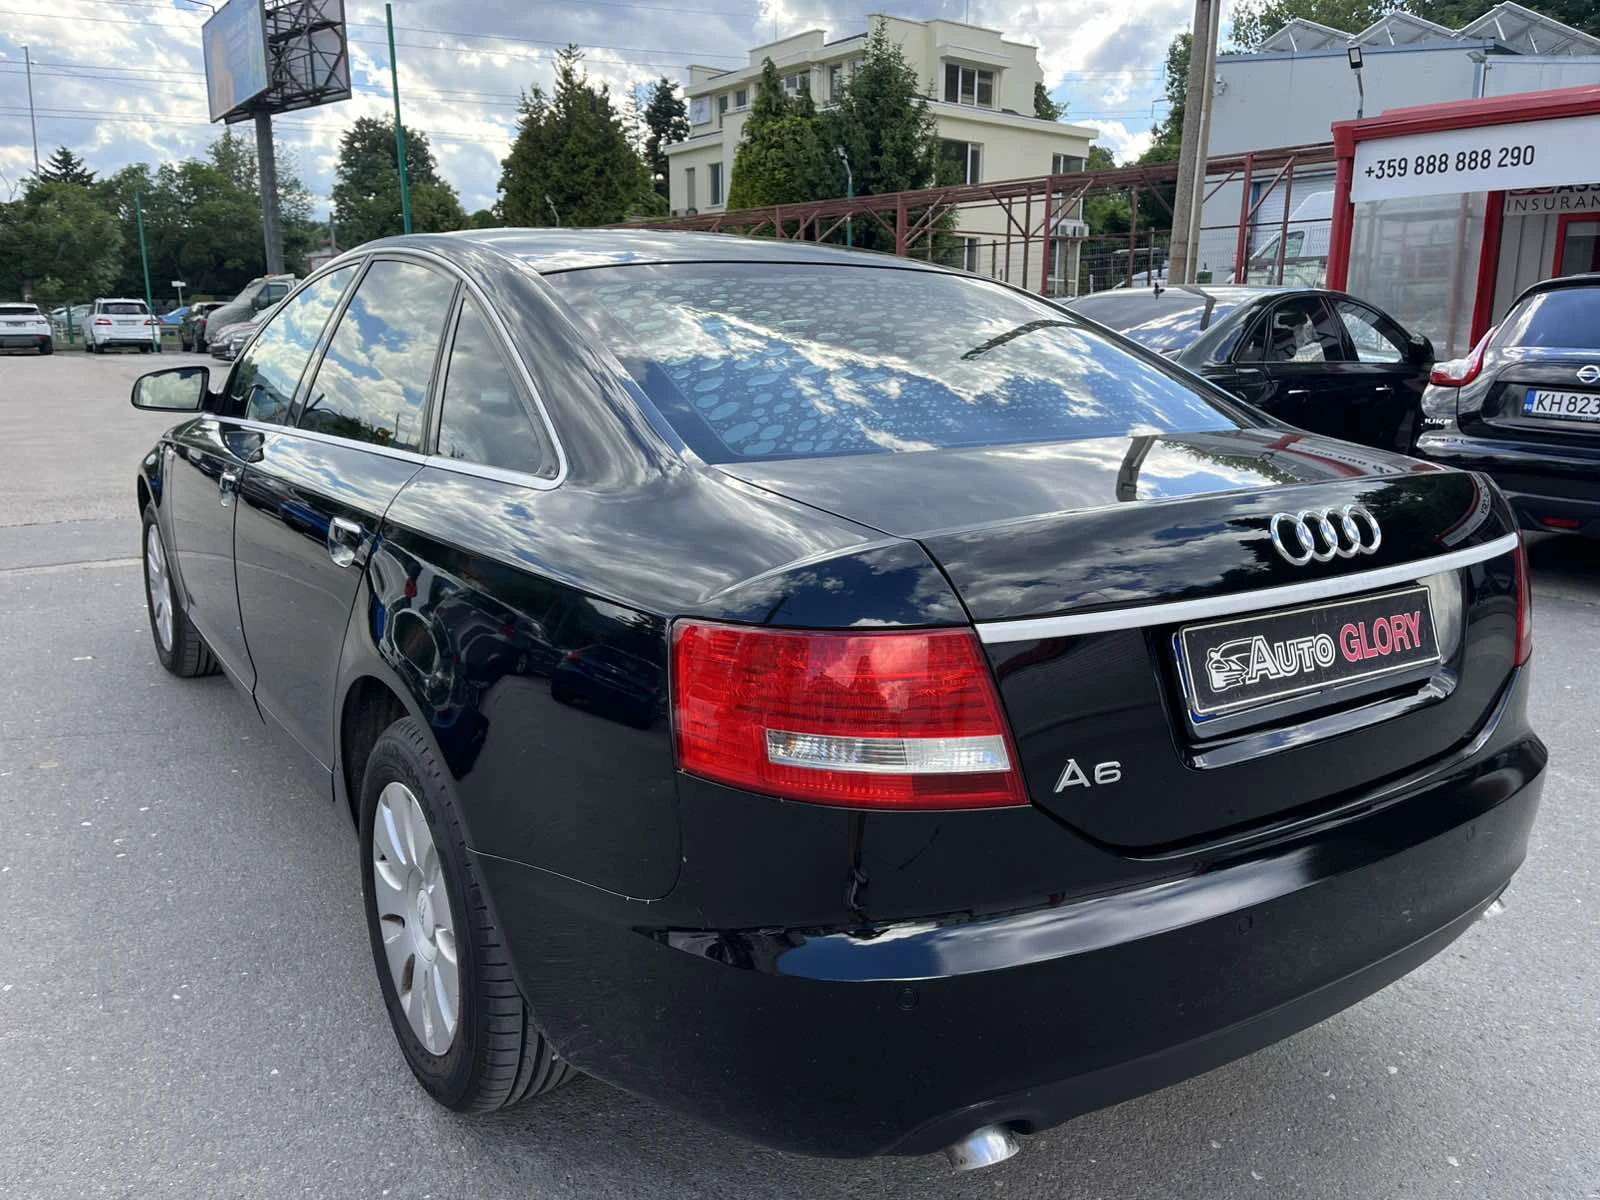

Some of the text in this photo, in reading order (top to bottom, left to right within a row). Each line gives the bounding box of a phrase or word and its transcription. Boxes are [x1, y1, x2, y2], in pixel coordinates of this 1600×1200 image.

[1365, 145, 1535, 179] +359 888 888 290
[1535, 393, 1600, 415] KH 823
[1246, 610, 1422, 684] AUTO GLORY
[1053, 758, 1123, 794] A6
